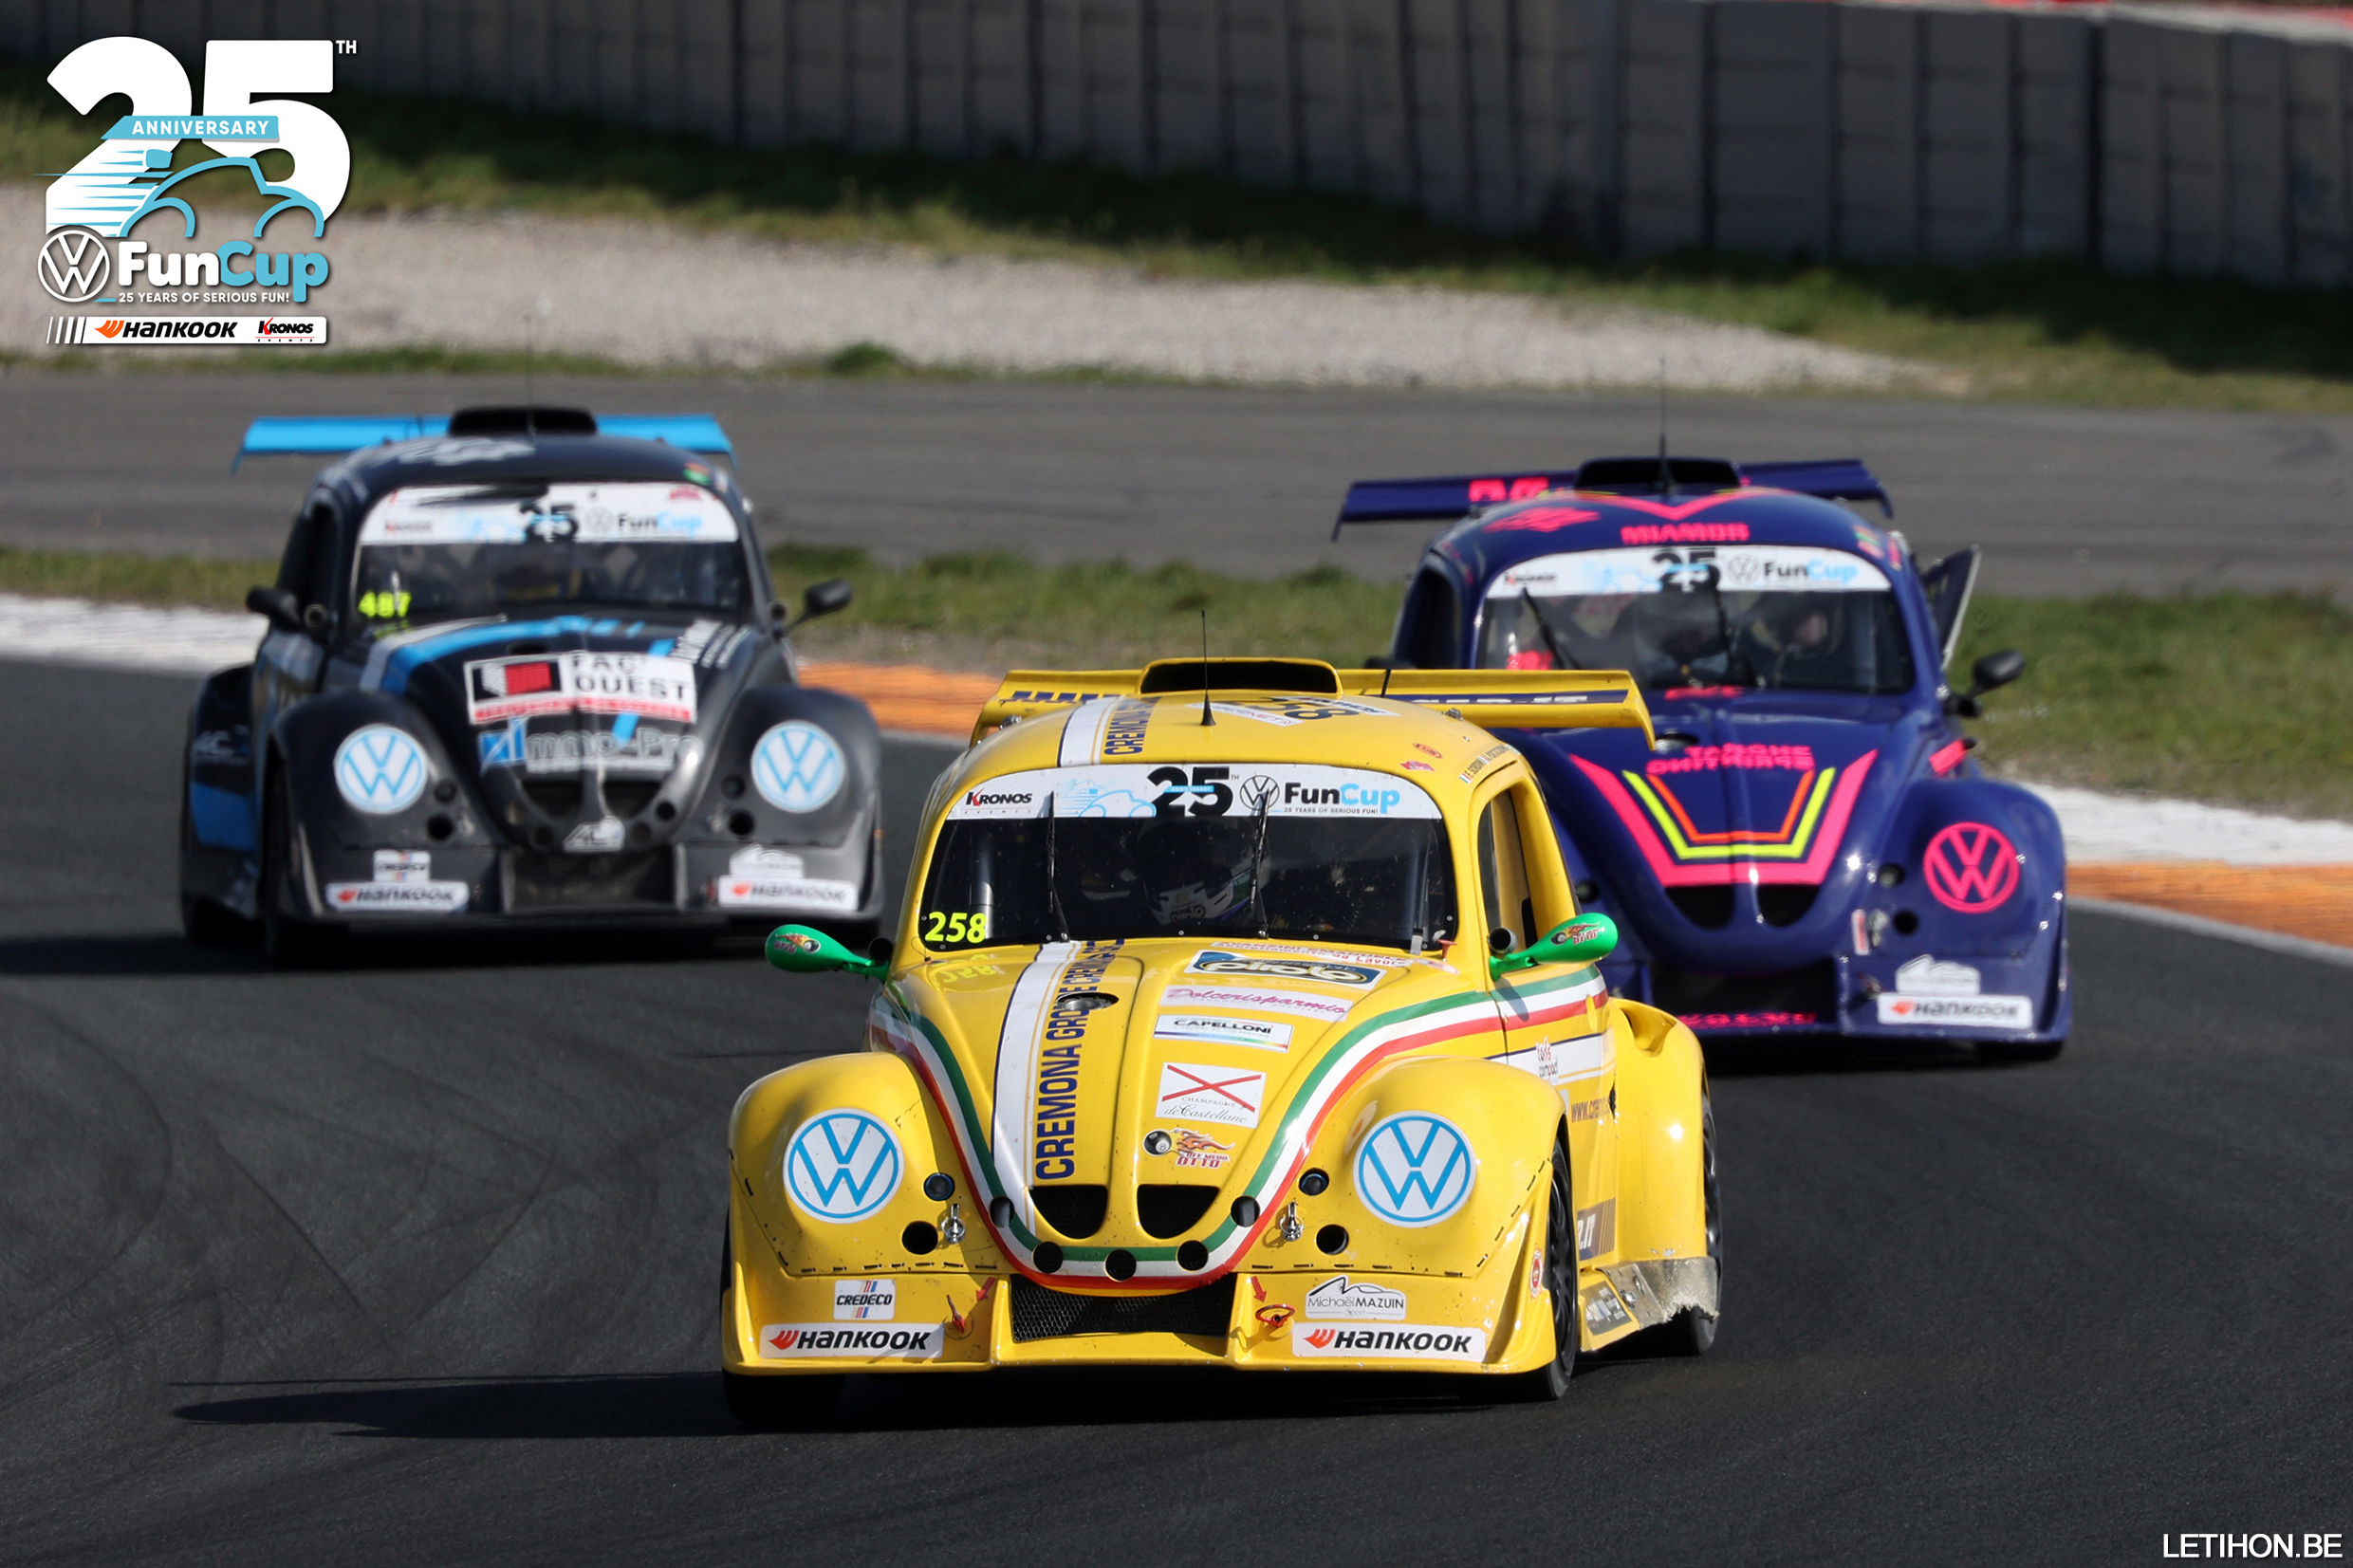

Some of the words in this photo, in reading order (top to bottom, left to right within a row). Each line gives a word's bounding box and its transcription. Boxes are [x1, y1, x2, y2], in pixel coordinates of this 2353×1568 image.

[519, 502, 581, 544] 25
[619, 512, 703, 536] FunCup
[1652, 547, 1721, 592] 25
[1764, 561, 1859, 585] FunCup
[576, 673, 690, 701] OUEST
[966, 787, 1033, 806] KRONOS
[1146, 766, 1233, 817] 25
[1285, 783, 1400, 813] FunCup
[925, 912, 987, 943] 258
[1174, 1020, 1271, 1034] CAPELLONI
[1035, 1043, 1083, 1179] CREMONA
[1181, 1097, 1235, 1107] CHAMPAGNE
[1176, 1156, 1220, 1168] OTTO
[836, 1294, 893, 1305] CREDECO
